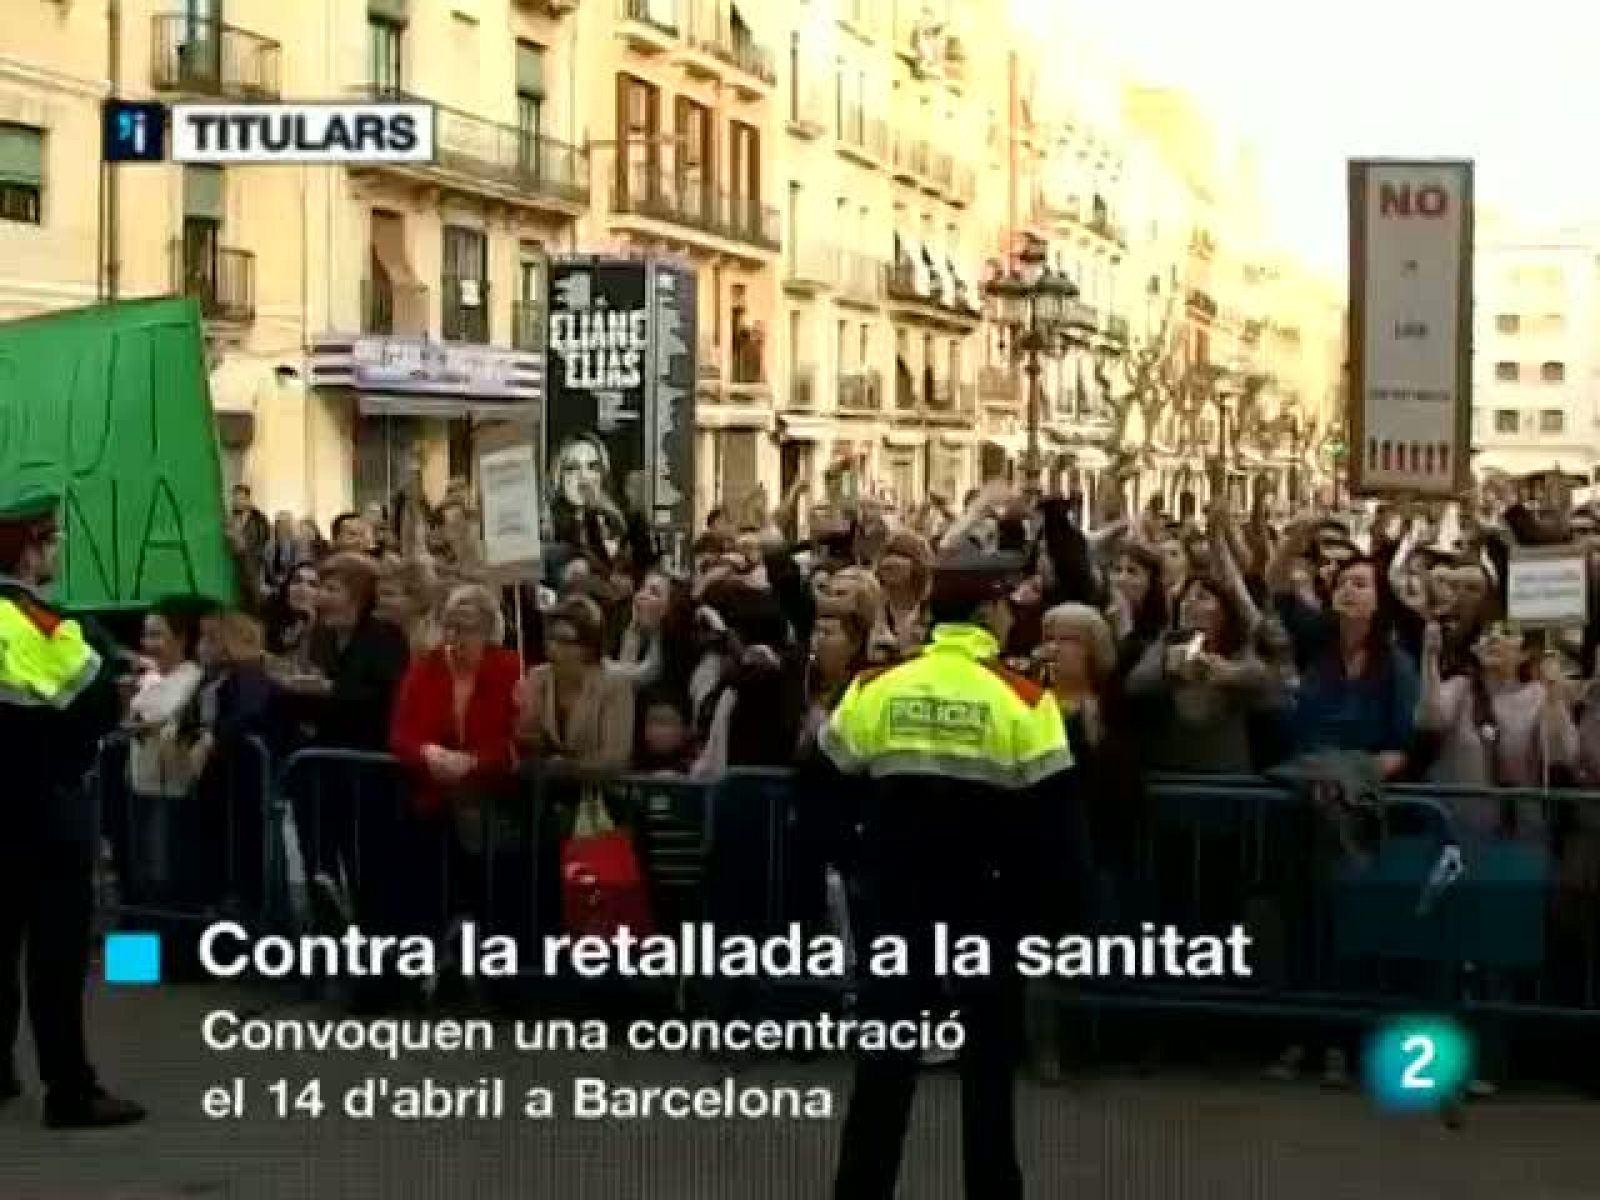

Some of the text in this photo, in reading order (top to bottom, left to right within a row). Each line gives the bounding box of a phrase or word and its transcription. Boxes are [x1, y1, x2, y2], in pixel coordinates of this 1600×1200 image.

[1379, 180, 1449, 218] NO
[549, 310, 647, 351] ELIANE
[564, 349, 642, 389] ELIAS
